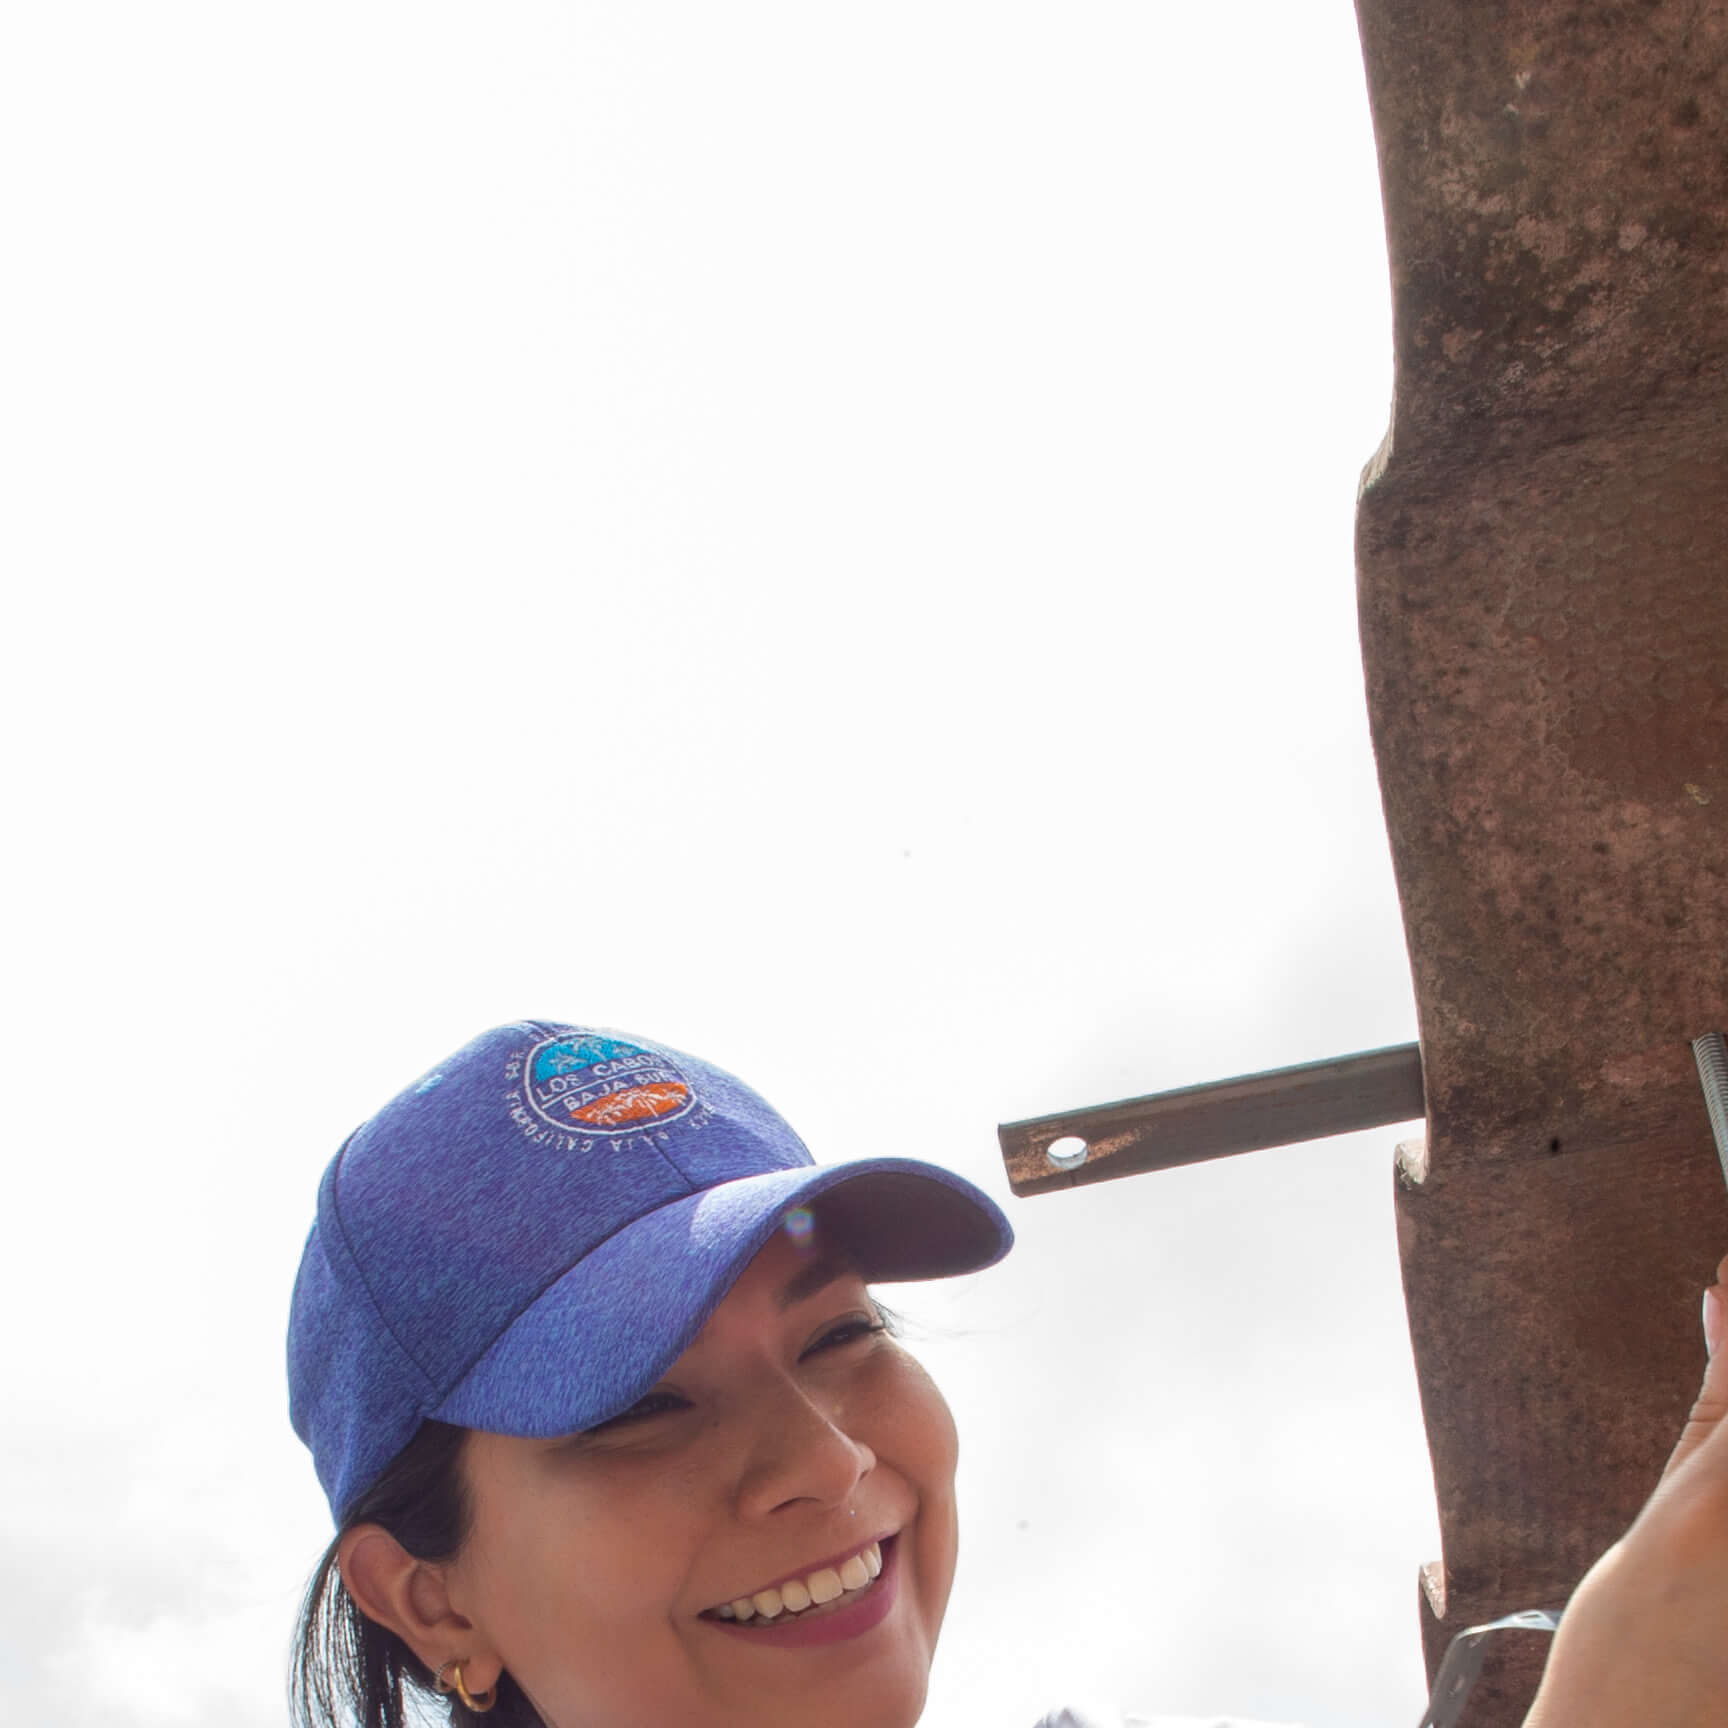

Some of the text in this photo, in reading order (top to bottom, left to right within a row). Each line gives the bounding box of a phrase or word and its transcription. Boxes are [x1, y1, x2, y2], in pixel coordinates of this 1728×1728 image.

[536, 1053, 666, 1101] LOS CABOS
[563, 1080, 628, 1111] BAJA
